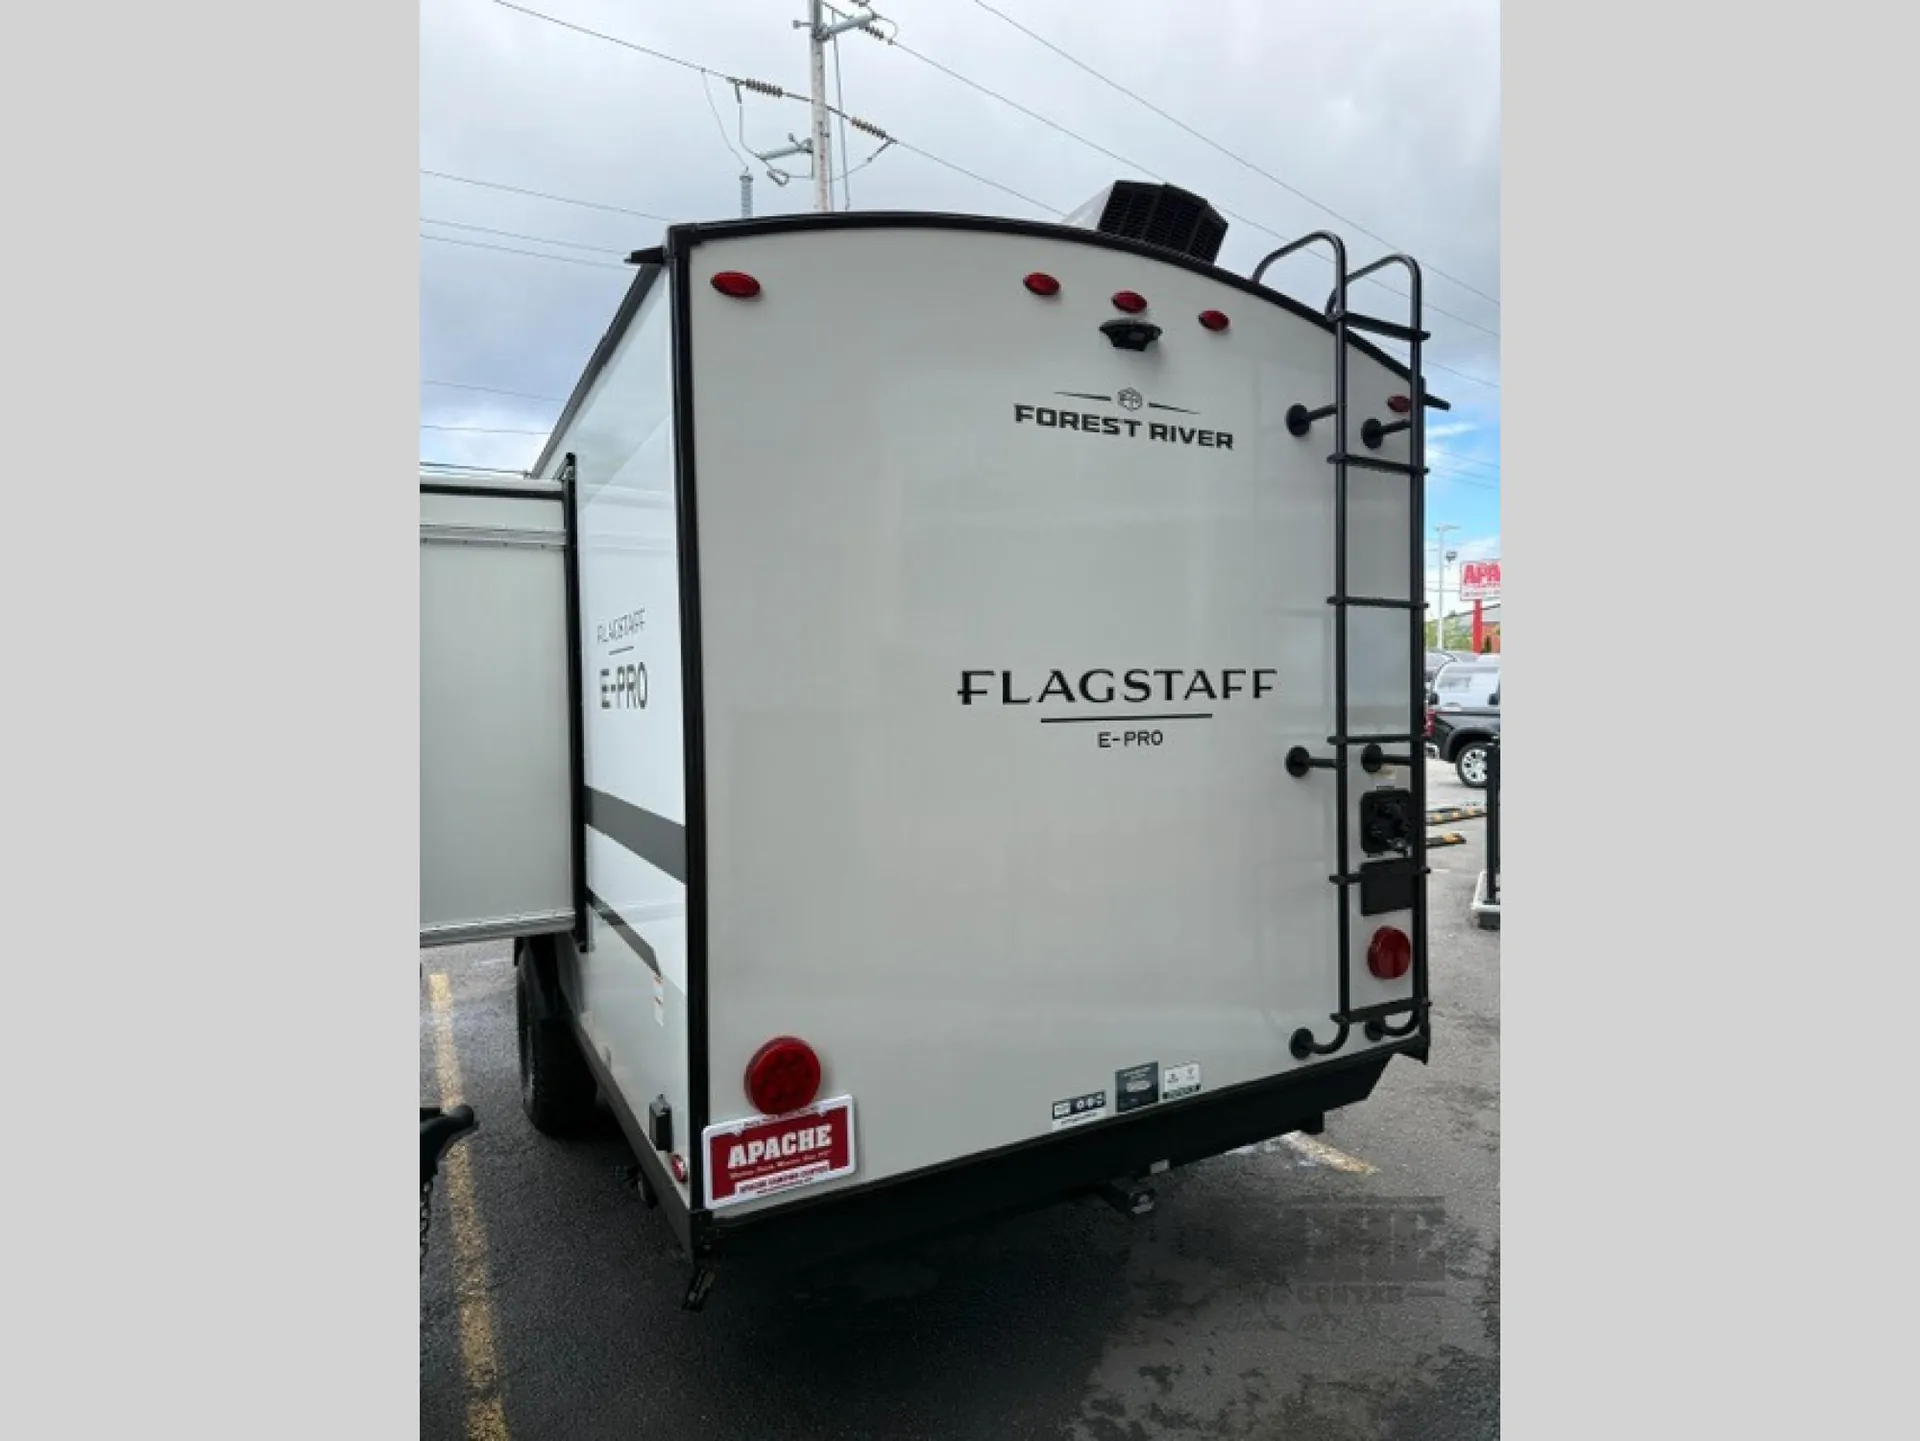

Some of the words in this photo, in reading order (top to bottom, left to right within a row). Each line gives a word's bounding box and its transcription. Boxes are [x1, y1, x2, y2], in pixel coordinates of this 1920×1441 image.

[1014, 403, 1142, 438] FOREST
[1149, 421, 1234, 451] RIVER
[597, 607, 645, 643] FLAGSTAFF
[600, 661, 648, 709] E-PRO
[957, 668, 1278, 705] FLAGSTAFF
[1098, 729, 1164, 748] E-PRO
[727, 1123, 833, 1169] APACHE
